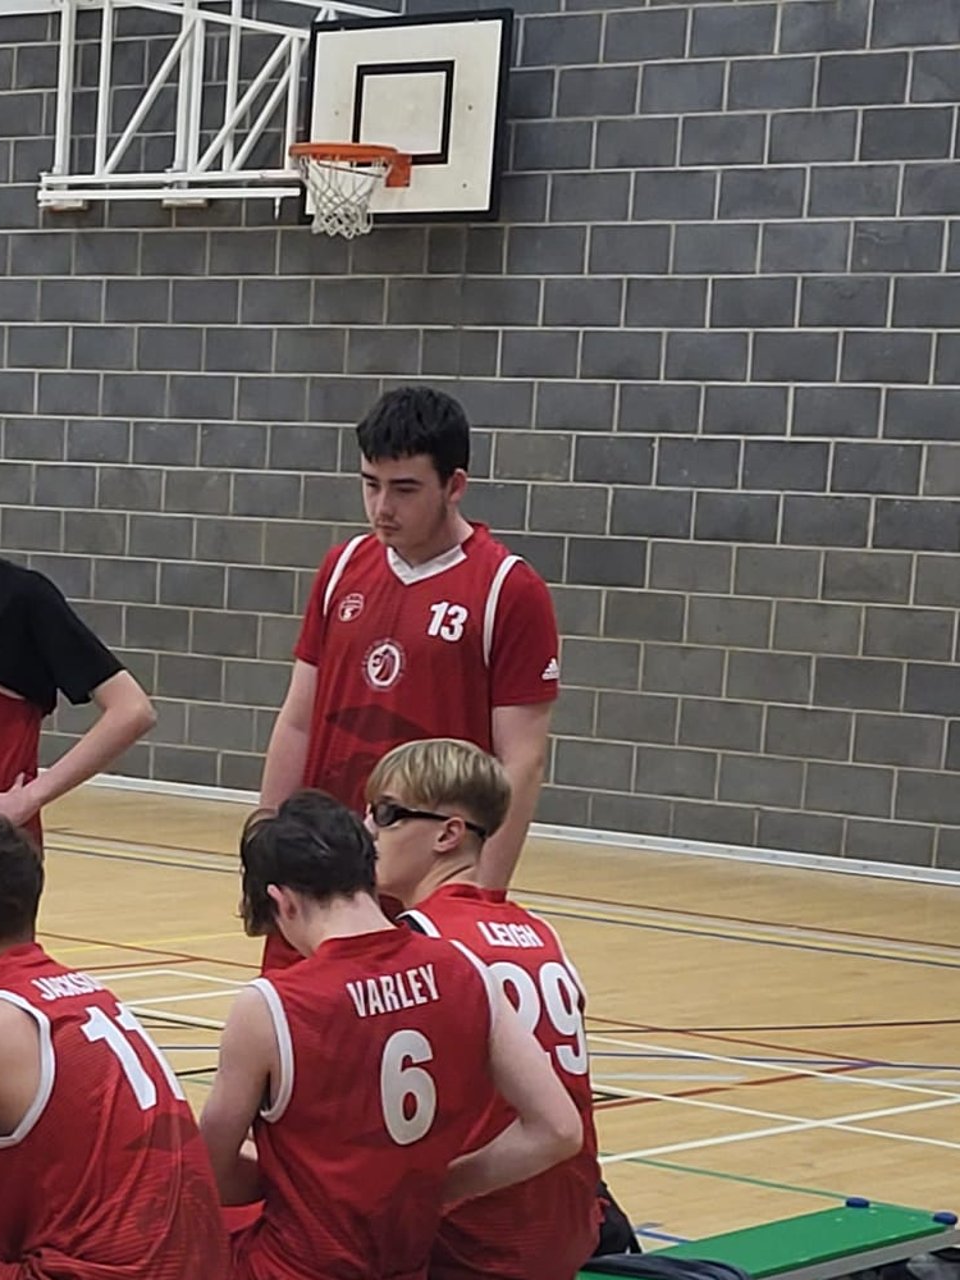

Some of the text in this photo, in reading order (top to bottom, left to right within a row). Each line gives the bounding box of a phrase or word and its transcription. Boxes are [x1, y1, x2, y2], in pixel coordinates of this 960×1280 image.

[427, 601, 468, 642] 13
[476, 921, 545, 948] LEIGH
[345, 963, 440, 1018] VARLEY
[80, 1002, 187, 1110] 11
[380, 1029, 437, 1145] 6
